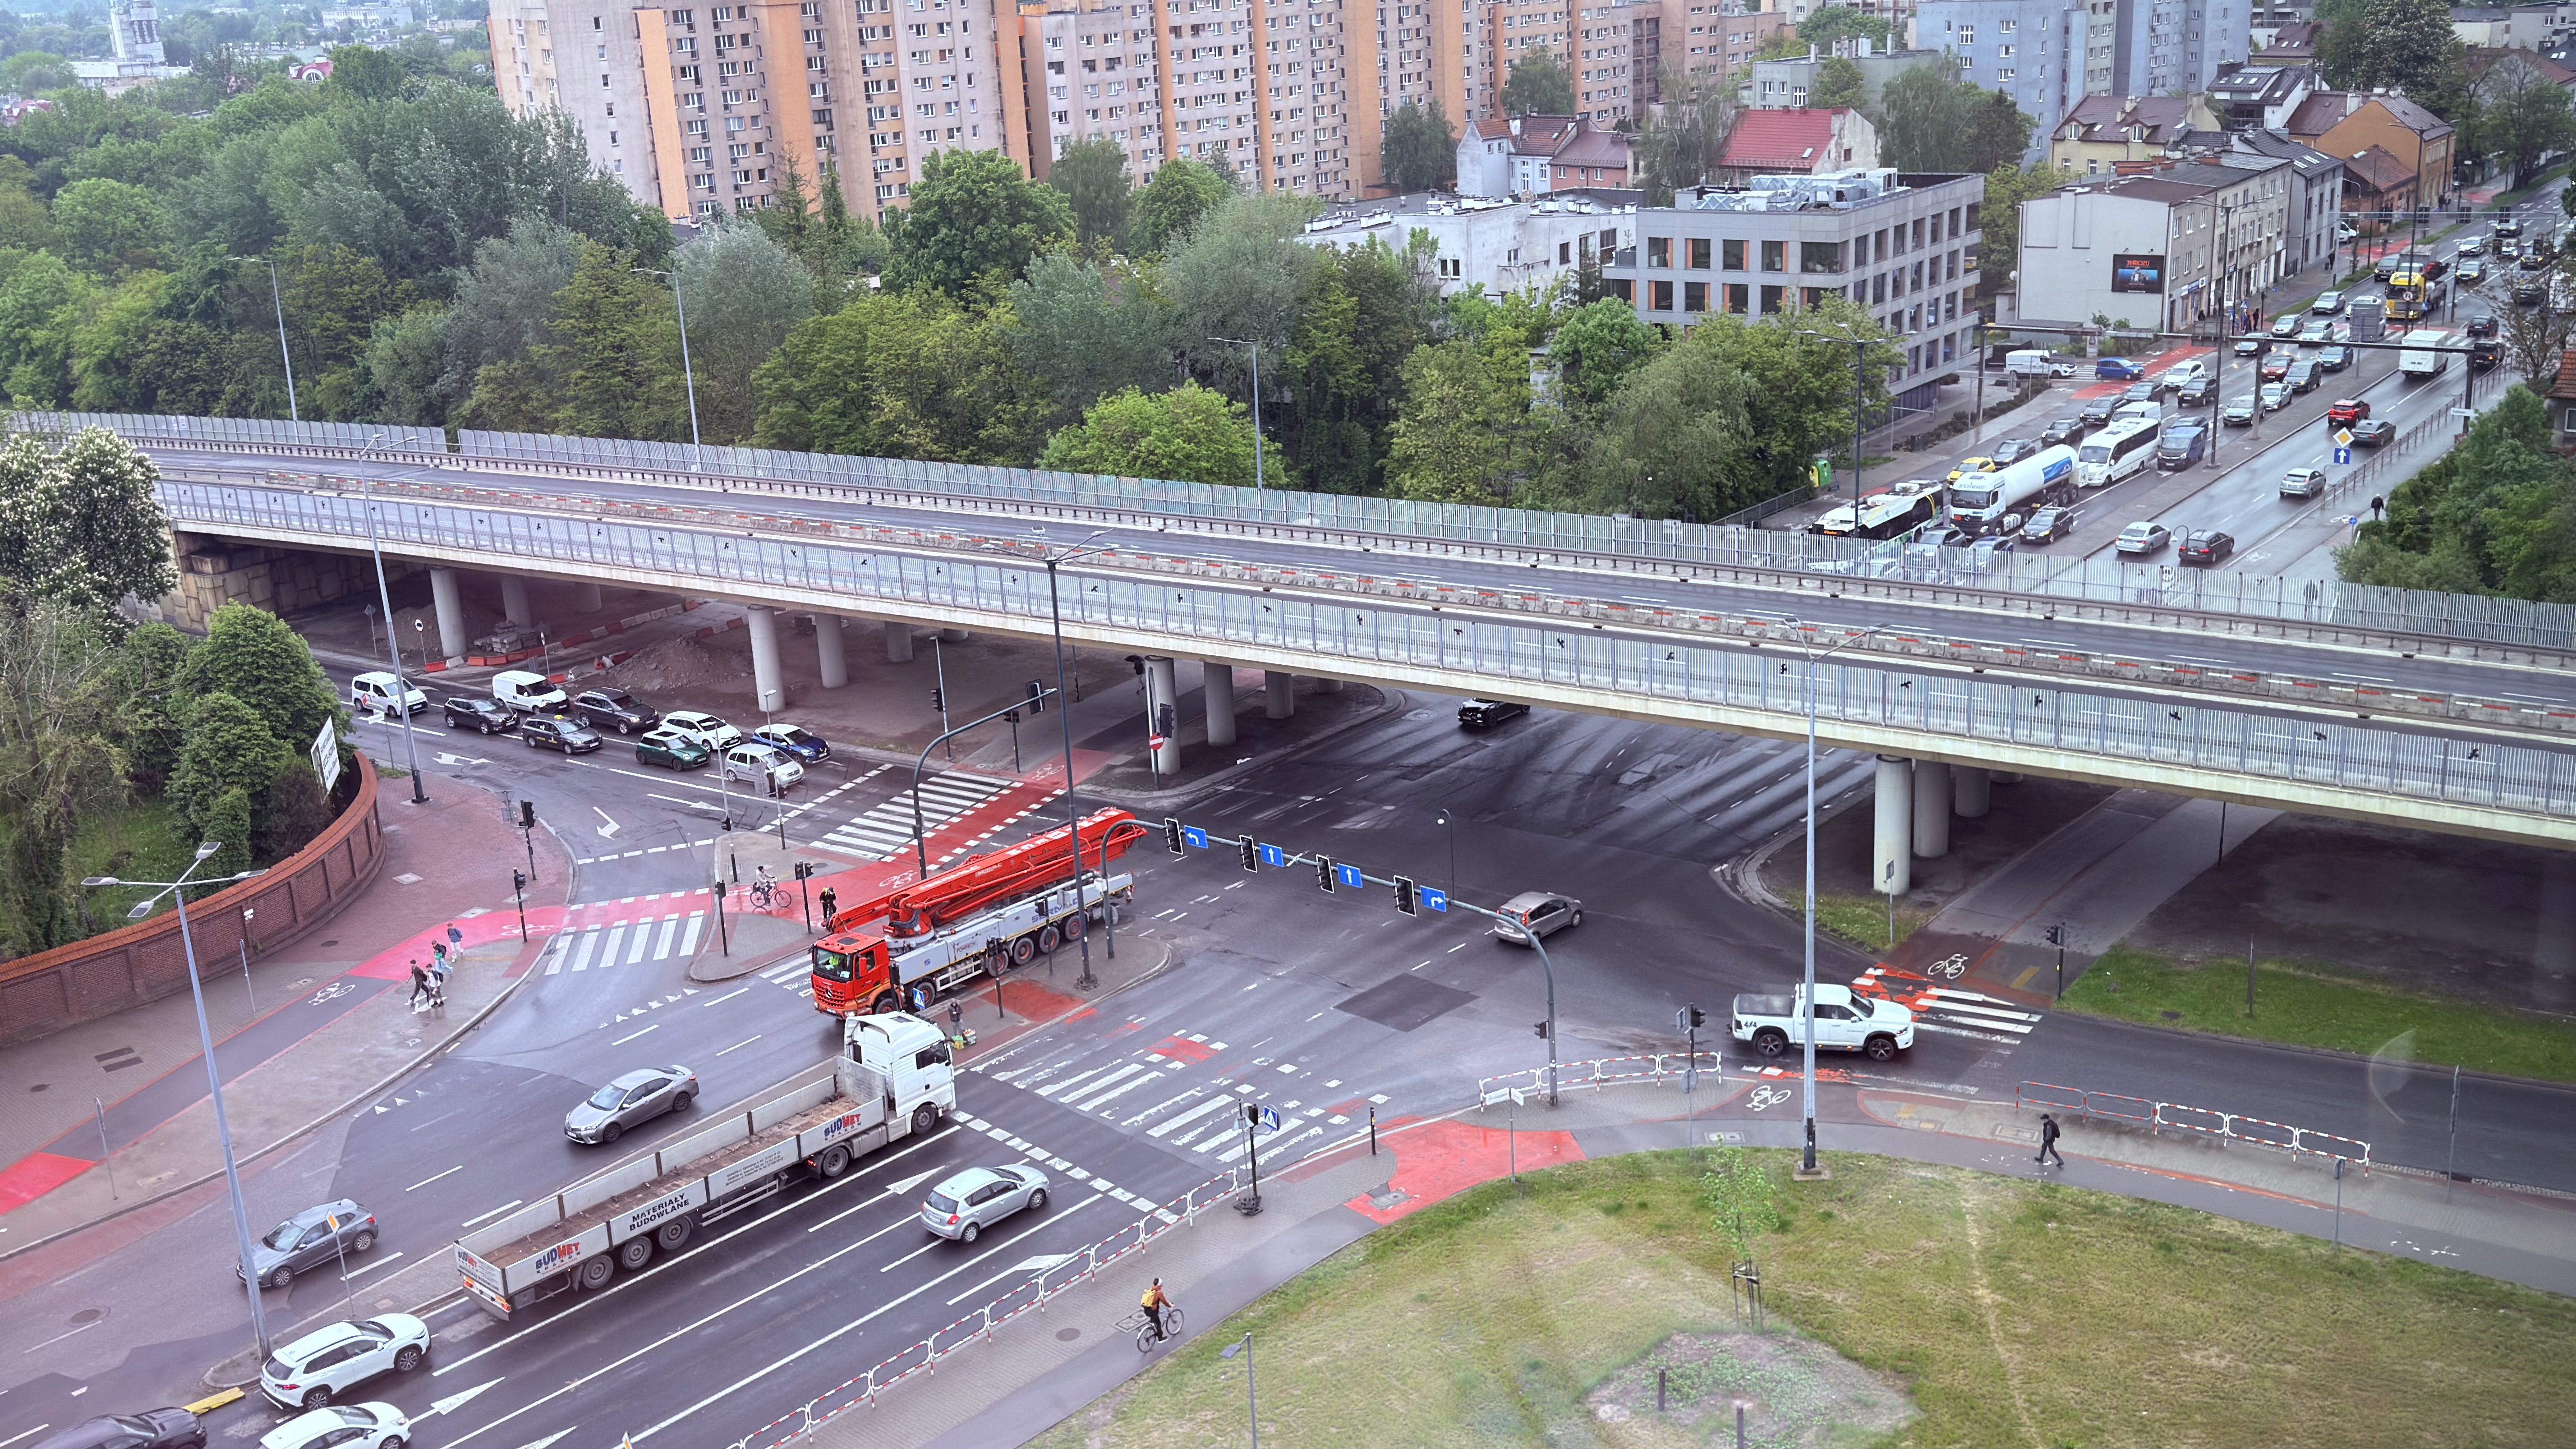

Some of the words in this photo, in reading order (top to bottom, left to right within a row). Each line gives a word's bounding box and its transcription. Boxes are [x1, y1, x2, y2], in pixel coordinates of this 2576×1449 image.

[824, 1114, 860, 1137] BUDMET
[630, 1199, 690, 1231] BUDOWLANE
[632, 1193, 685, 1222] MATERIAŁY
[536, 1242, 580, 1270] BUDMET
